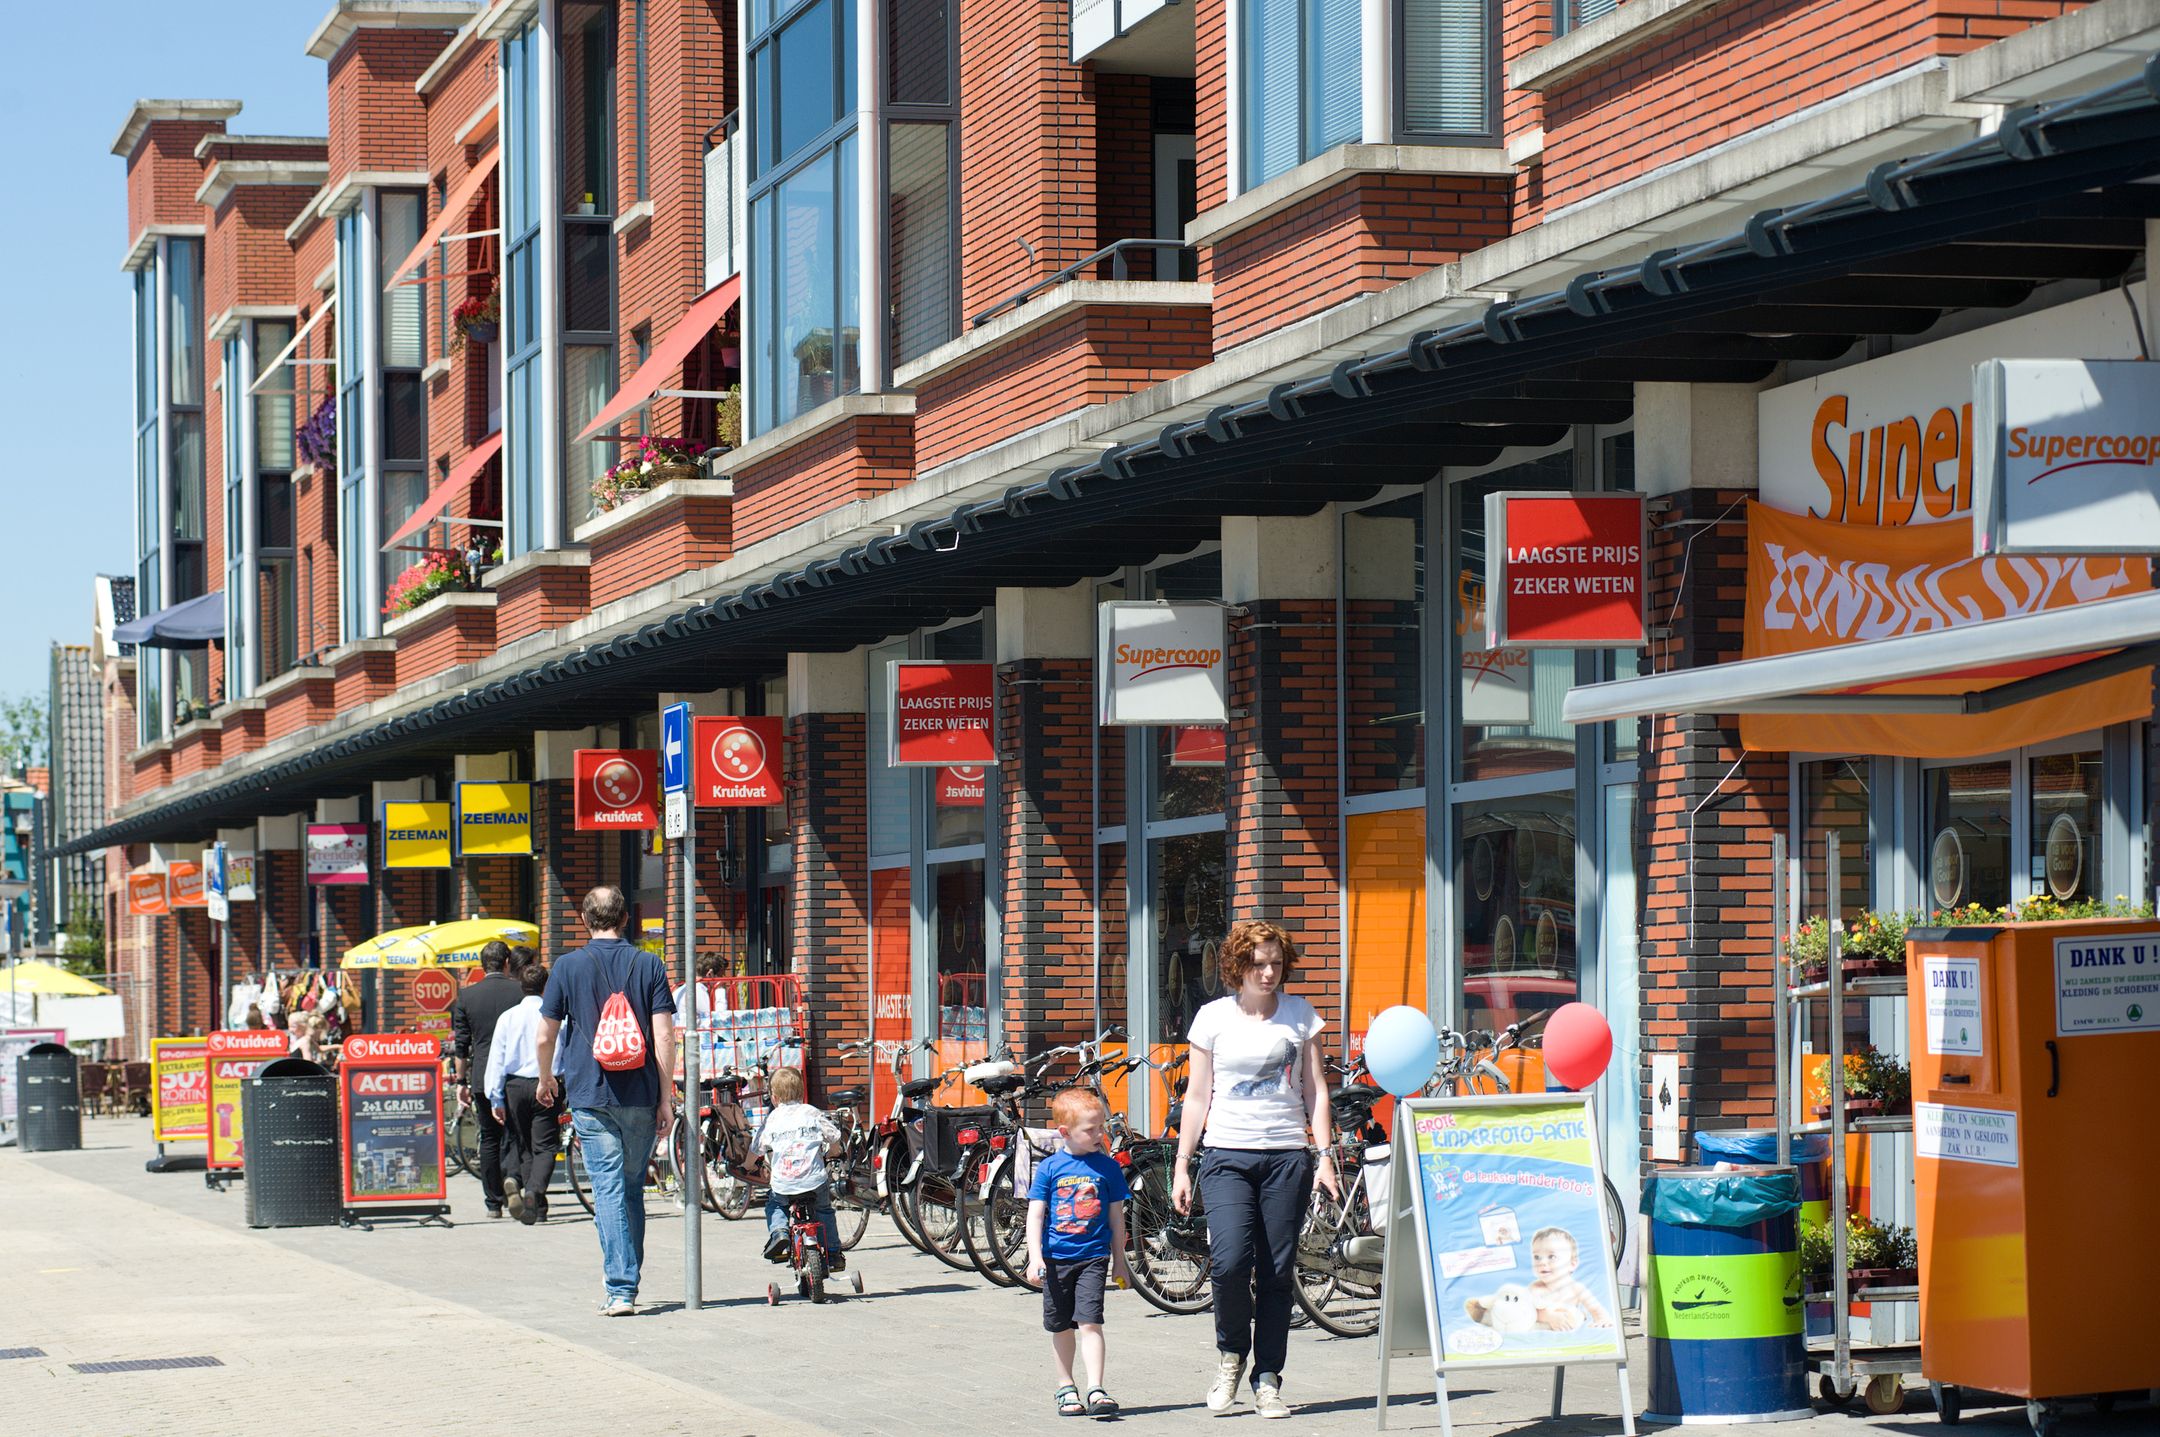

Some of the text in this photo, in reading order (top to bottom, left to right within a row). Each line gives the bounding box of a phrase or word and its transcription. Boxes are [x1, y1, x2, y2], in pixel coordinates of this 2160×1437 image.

[1507, 546, 1640, 566] LAAGSTE PRIJS
[1513, 576, 1635, 594] ZEKER WETEN
[1116, 643, 1221, 669] Supercoop
[899, 696, 993, 711] LAAGSTE PRIJS
[903, 717, 990, 731] ZEKER WETEN
[713, 785, 767, 798] Kruidvat
[463, 813, 528, 825] ZEEMAN
[594, 811, 644, 823] Kruidvat
[388, 829, 448, 841] ZEEMAN
[385, 955, 417, 965] ZEEMAN
[2070, 946, 2126, 968] DANK
[2132, 945, 2146, 965] U
[1932, 970, 1959, 989] DANK
[1960, 970, 1967, 989] U
[416, 982, 450, 999] STOP
[2061, 987, 2100, 998] KLEDING
[2113, 984, 2160, 995] SCHOENEN
[226, 1034, 282, 1049] Kruidvat
[368, 1039, 435, 1056] Kruidvat
[219, 1061, 261, 1078] ACT
[358, 1073, 427, 1093] ACTIE!
[362, 1099, 425, 1112] 2+1 GRATIS
[1416, 1114, 1457, 1134] GROTE
[1958, 1112, 1968, 1124] EN
[1970, 1115, 2006, 1129] SCHOENEN
[1963, 1128, 1974, 1141] IN
[1974, 1130, 2009, 1145] GESLOTEN
[1947, 1142, 1961, 1154] ZAK
[1463, 1169, 1477, 1183] de
[1477, 1171, 1516, 1185] leukste
